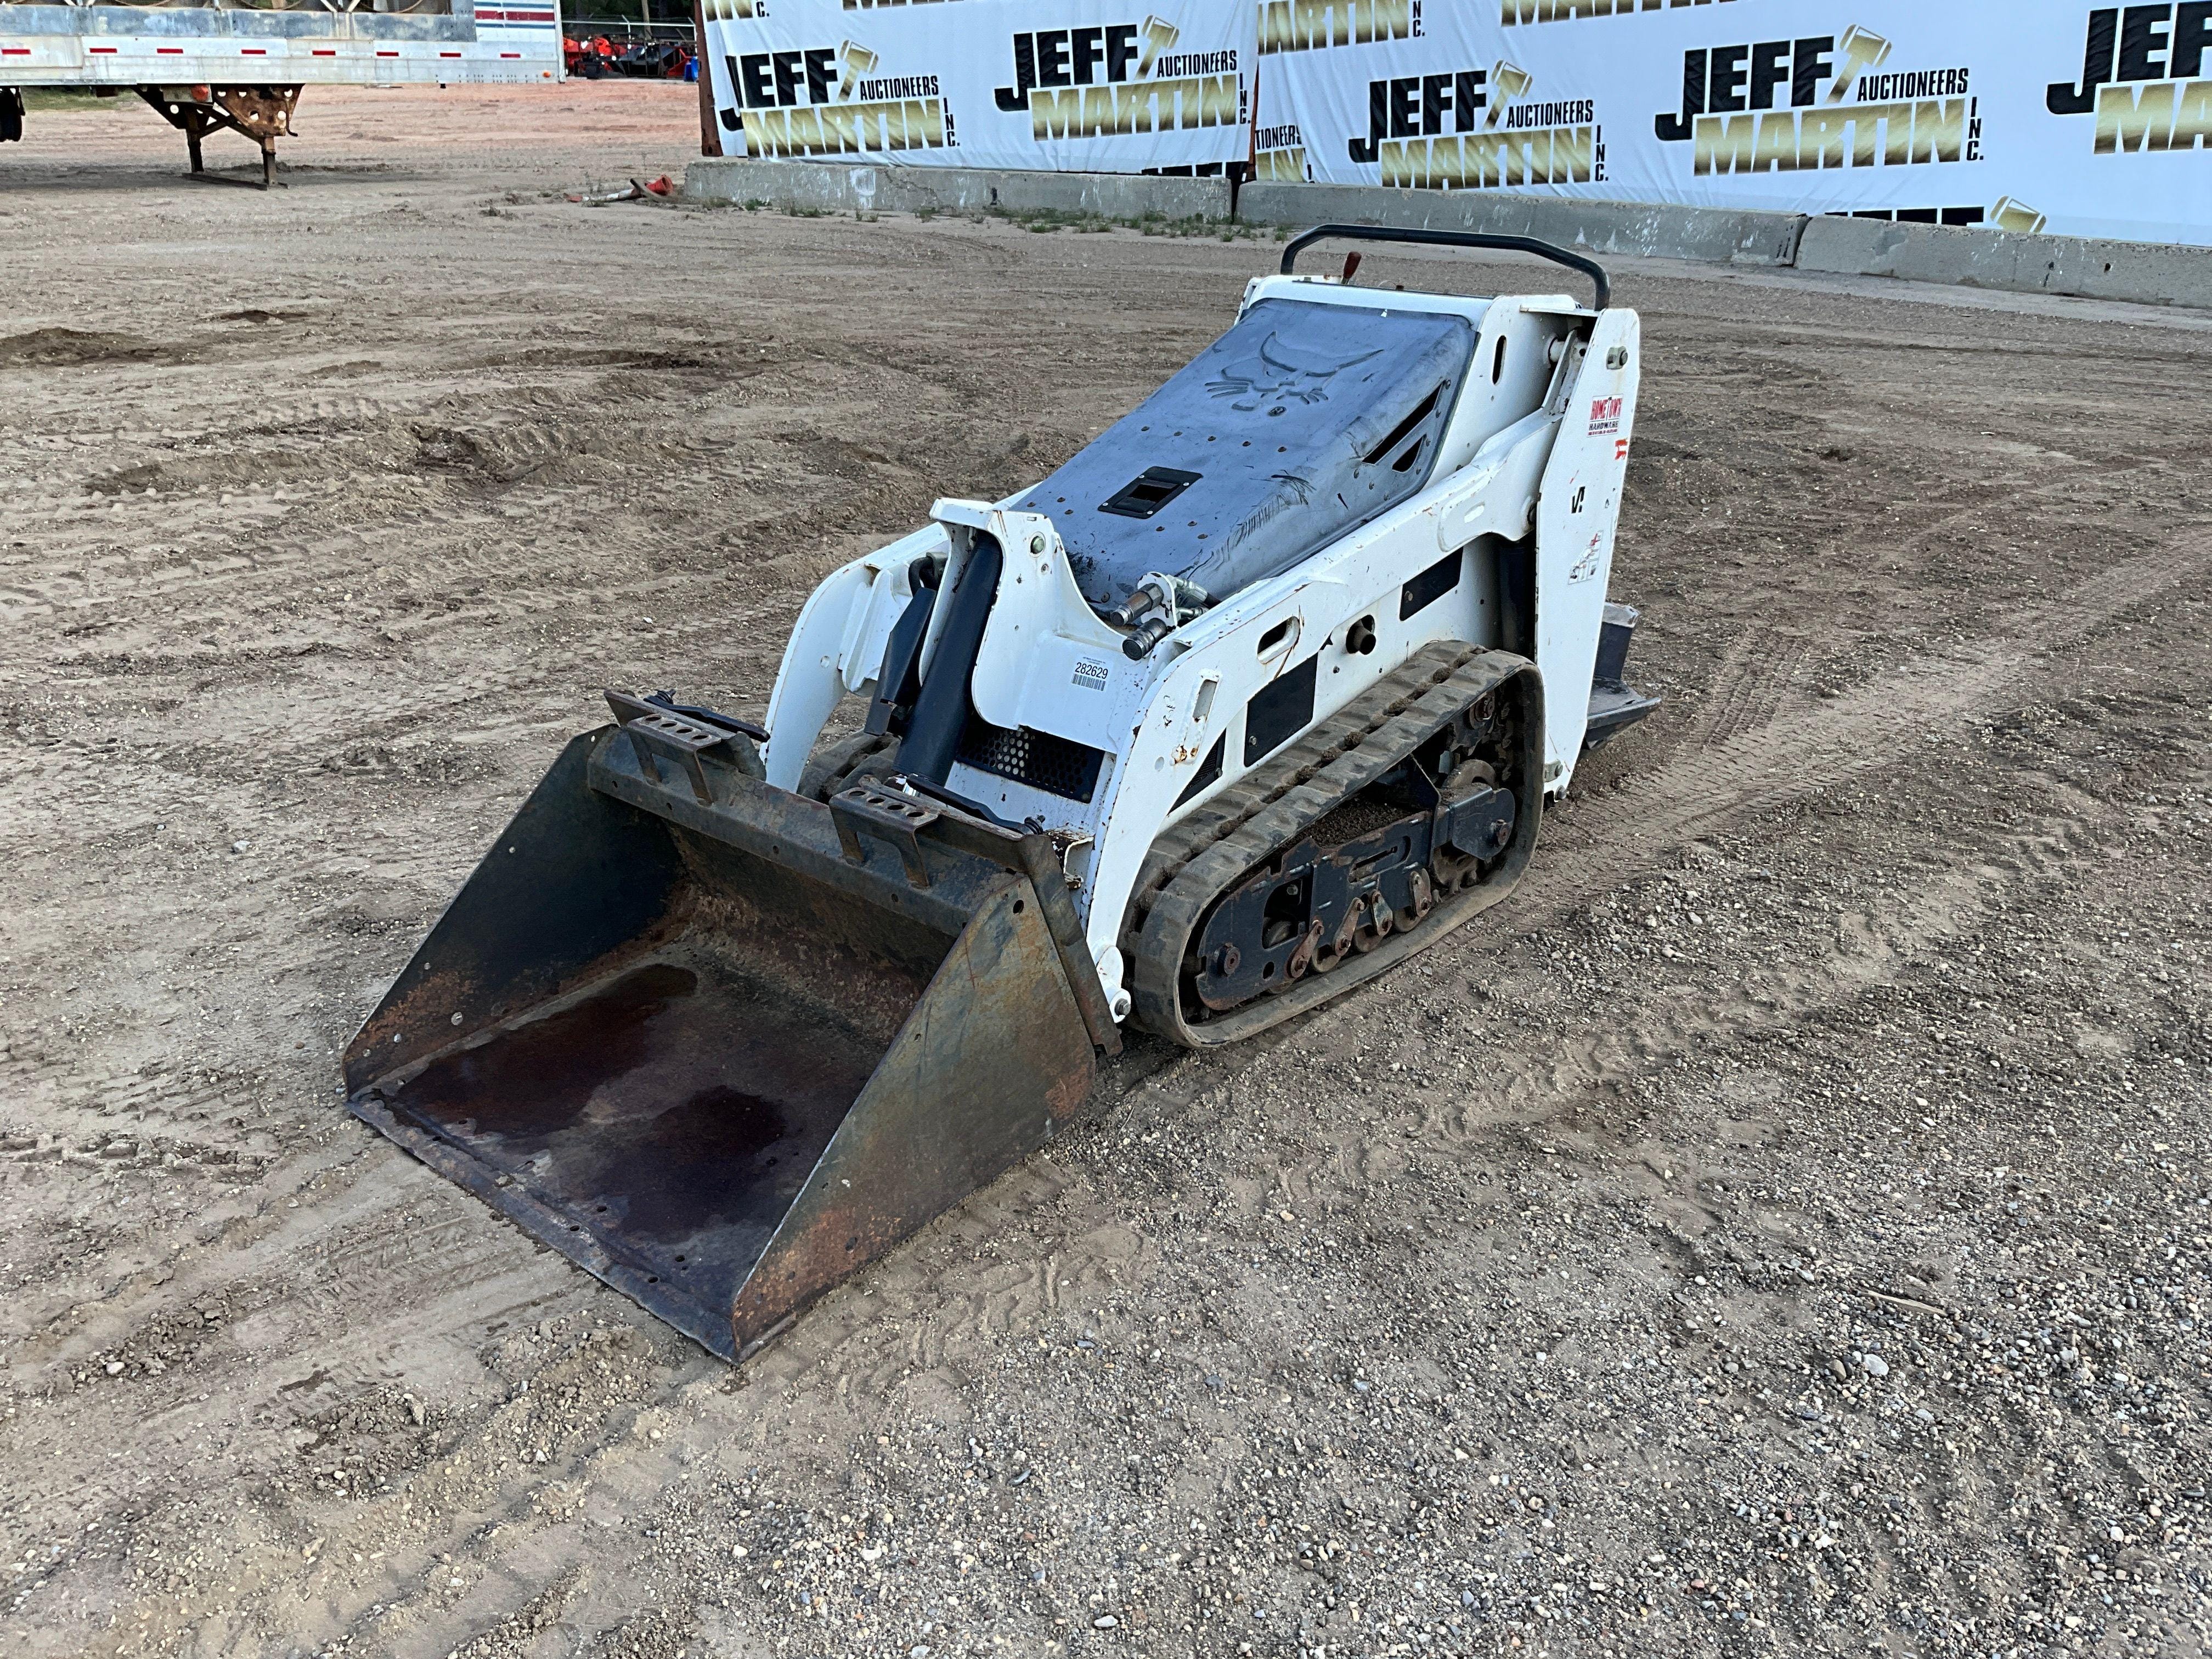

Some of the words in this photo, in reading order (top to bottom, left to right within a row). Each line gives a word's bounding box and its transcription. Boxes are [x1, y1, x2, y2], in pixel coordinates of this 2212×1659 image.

[1258, 0, 1409, 56] ARTIN
[720, 48, 838, 131] JEFF
[860, 75, 939, 100] AUCTIONEERS
[994, 24, 1138, 112] JEFF
[1157, 50, 1237, 78] AUCTIONEERS
[1655, 36, 1834, 141] JEFF
[1858, 68, 1968, 102] AUCTIONEERS
[740, 99, 943, 157] MARTIN
[1031, 74, 1237, 142] MARTIN
[1348, 70, 1487, 163] JEFF
[1506, 100, 1594, 128] AUCTIONEERS
[1381, 126, 1592, 190] MARTIN
[1694, 98, 1965, 177] MARTIN
[1589, 420, 1619, 431] HARDWARE
[1075, 662, 1108, 680] 282629
